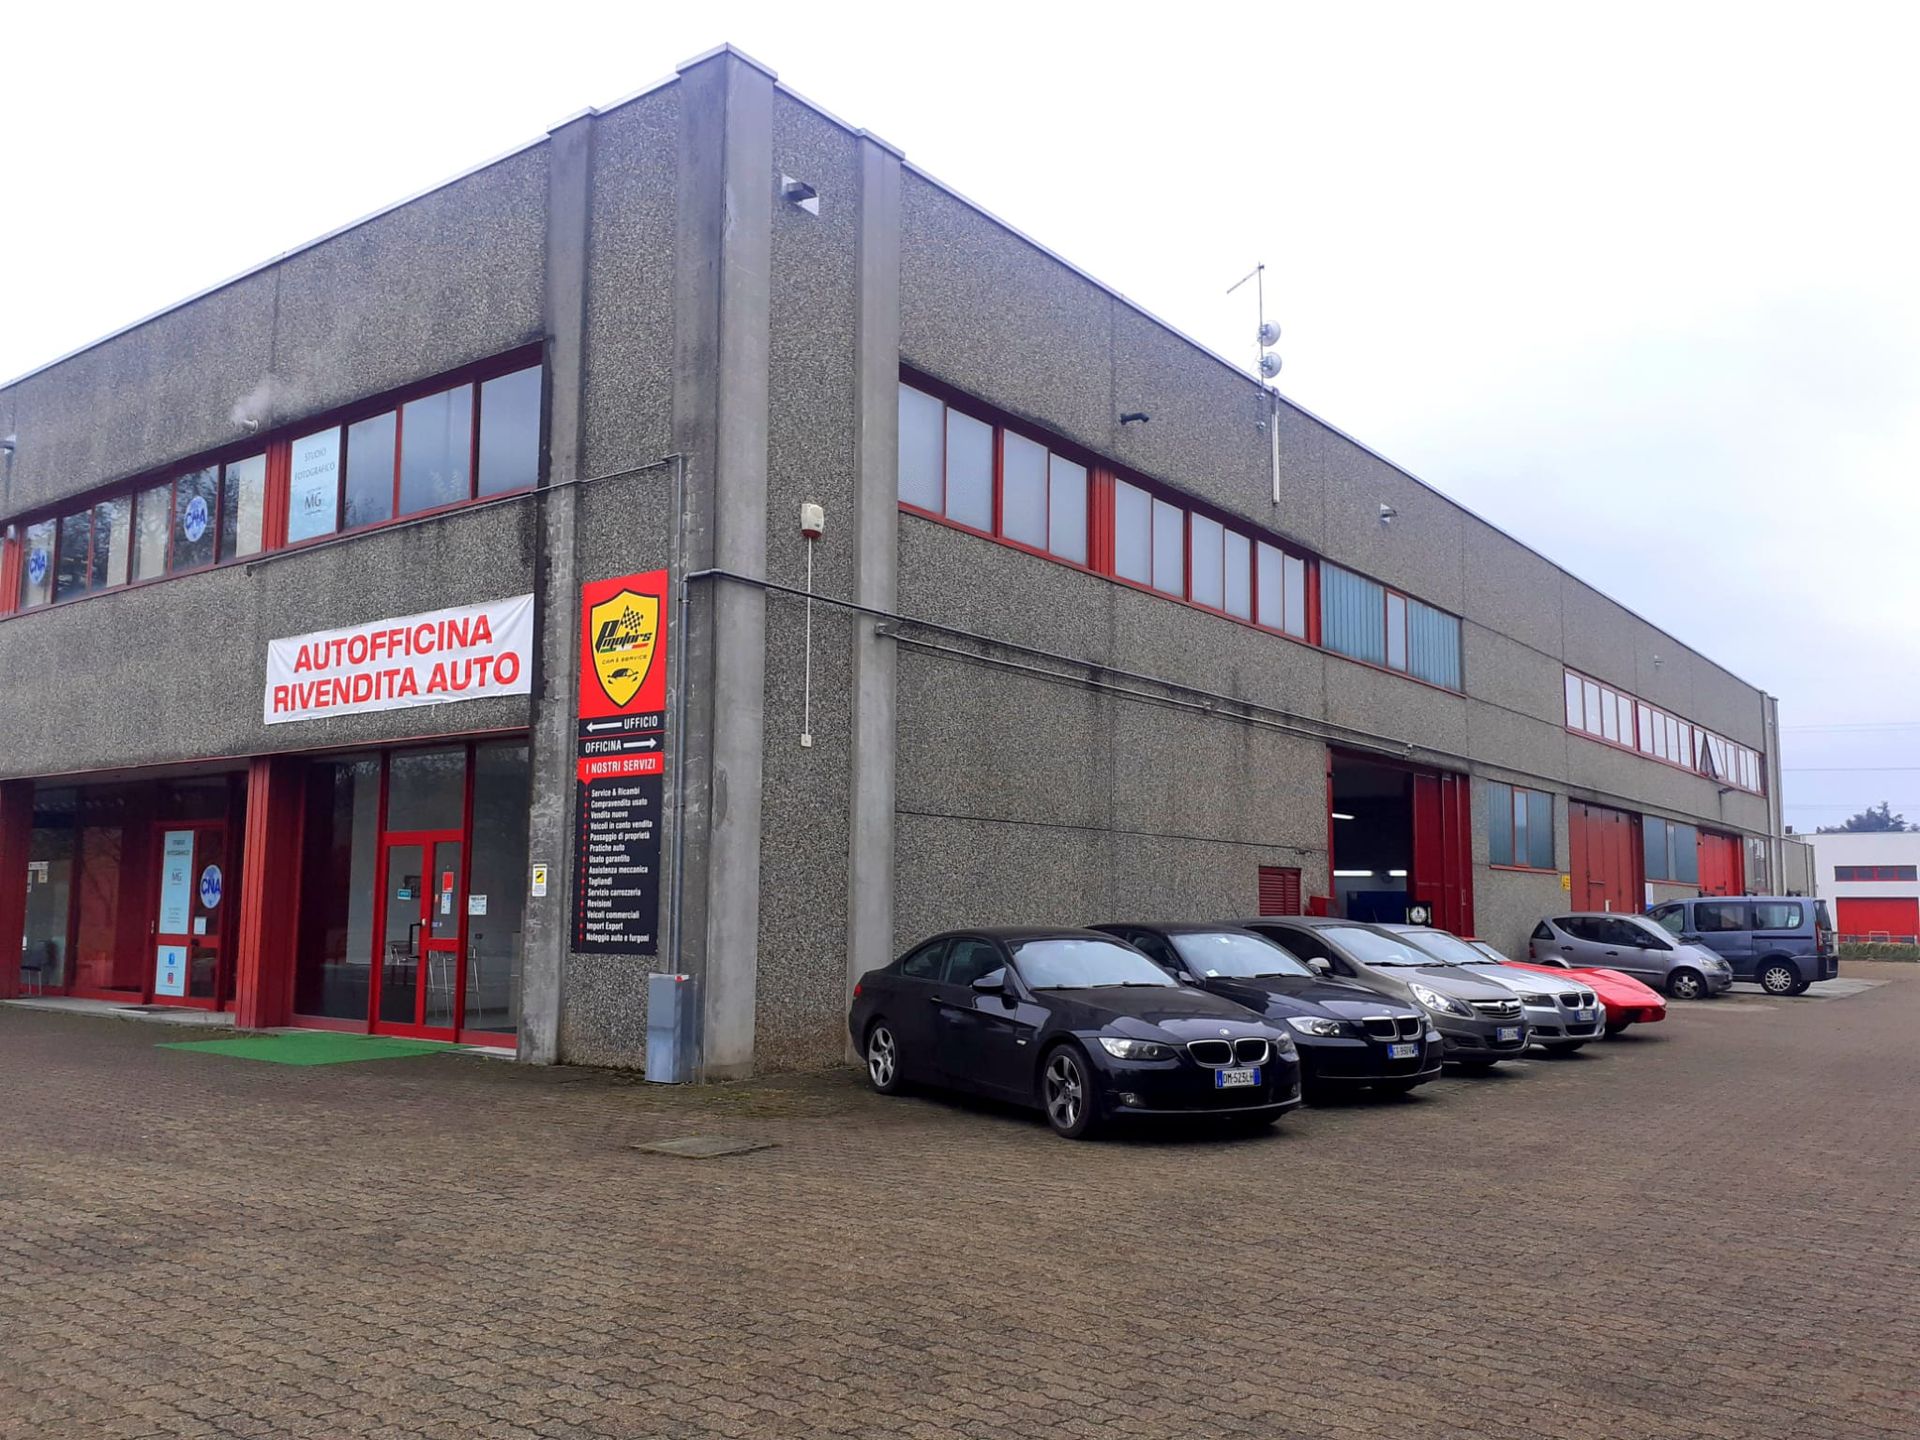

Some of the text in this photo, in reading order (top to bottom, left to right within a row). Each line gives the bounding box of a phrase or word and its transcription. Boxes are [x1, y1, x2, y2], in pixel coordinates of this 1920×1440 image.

[294, 614, 493, 673] AUTOFFICINA
[273, 651, 520, 713] RIVENDITA AUTO
[624, 715, 658, 730] UFFICIO
[585, 740, 622, 753] OFFICINA
[586, 758, 656, 775] I NOSTRI SERVIZI
[591, 789, 611, 797] Service
[201, 878, 221, 894] CNA
